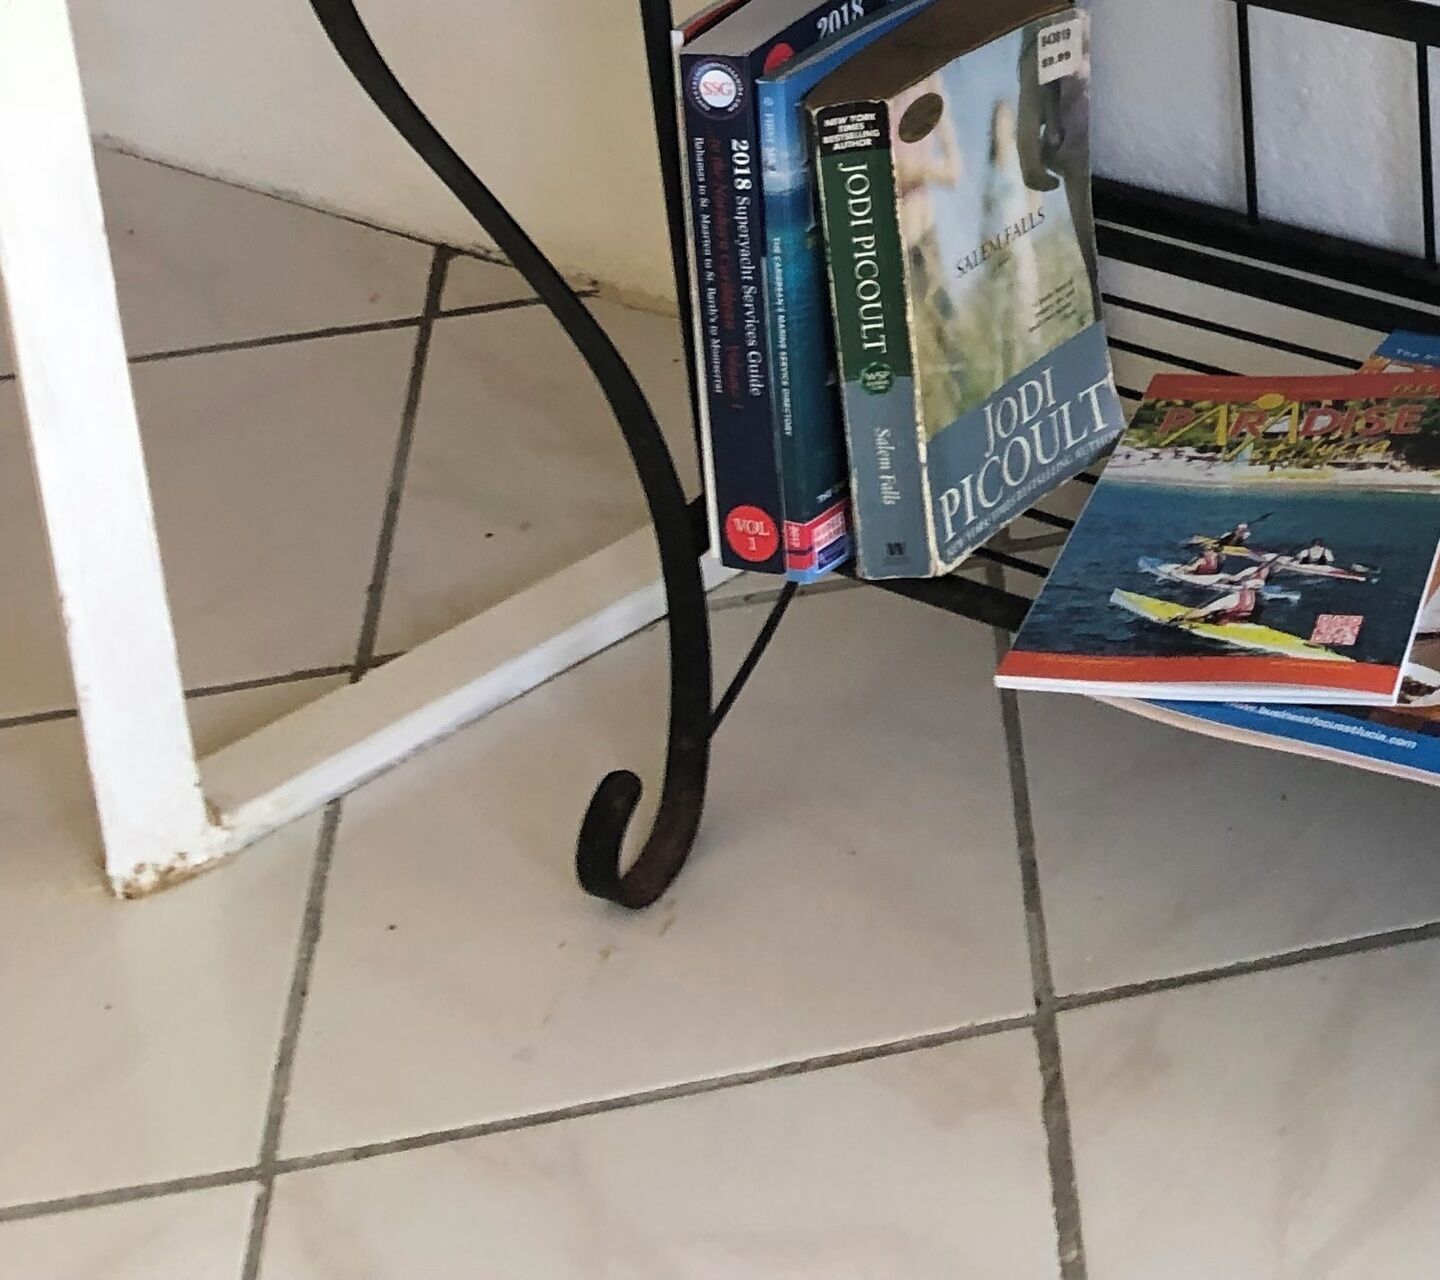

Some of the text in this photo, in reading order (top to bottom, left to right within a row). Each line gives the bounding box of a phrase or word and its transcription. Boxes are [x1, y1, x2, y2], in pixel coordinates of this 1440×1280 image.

[702, 80, 733, 97] SSG
[822, 112, 877, 128] NEW YORK
[822, 128, 881, 145] BESTSELLING
[832, 138, 873, 151] AUTHOR
[836, 122, 866, 133] TIMES
[693, 136, 710, 189] Bahamas
[837, 162, 874, 228] JODI
[730, 139, 765, 398] 2018 Superyacht Services Guide
[955, 206, 1046, 279] SALEM FALLS
[851, 234, 888, 354] PICOULT
[1395, 348, 1421, 362] The
[982, 366, 1058, 459] JODI
[1158, 393, 1428, 461] PARADISE
[873, 425, 902, 506] Salem Falls
[938, 376, 1115, 544] PICOULT
[732, 517, 771, 538] VOL
